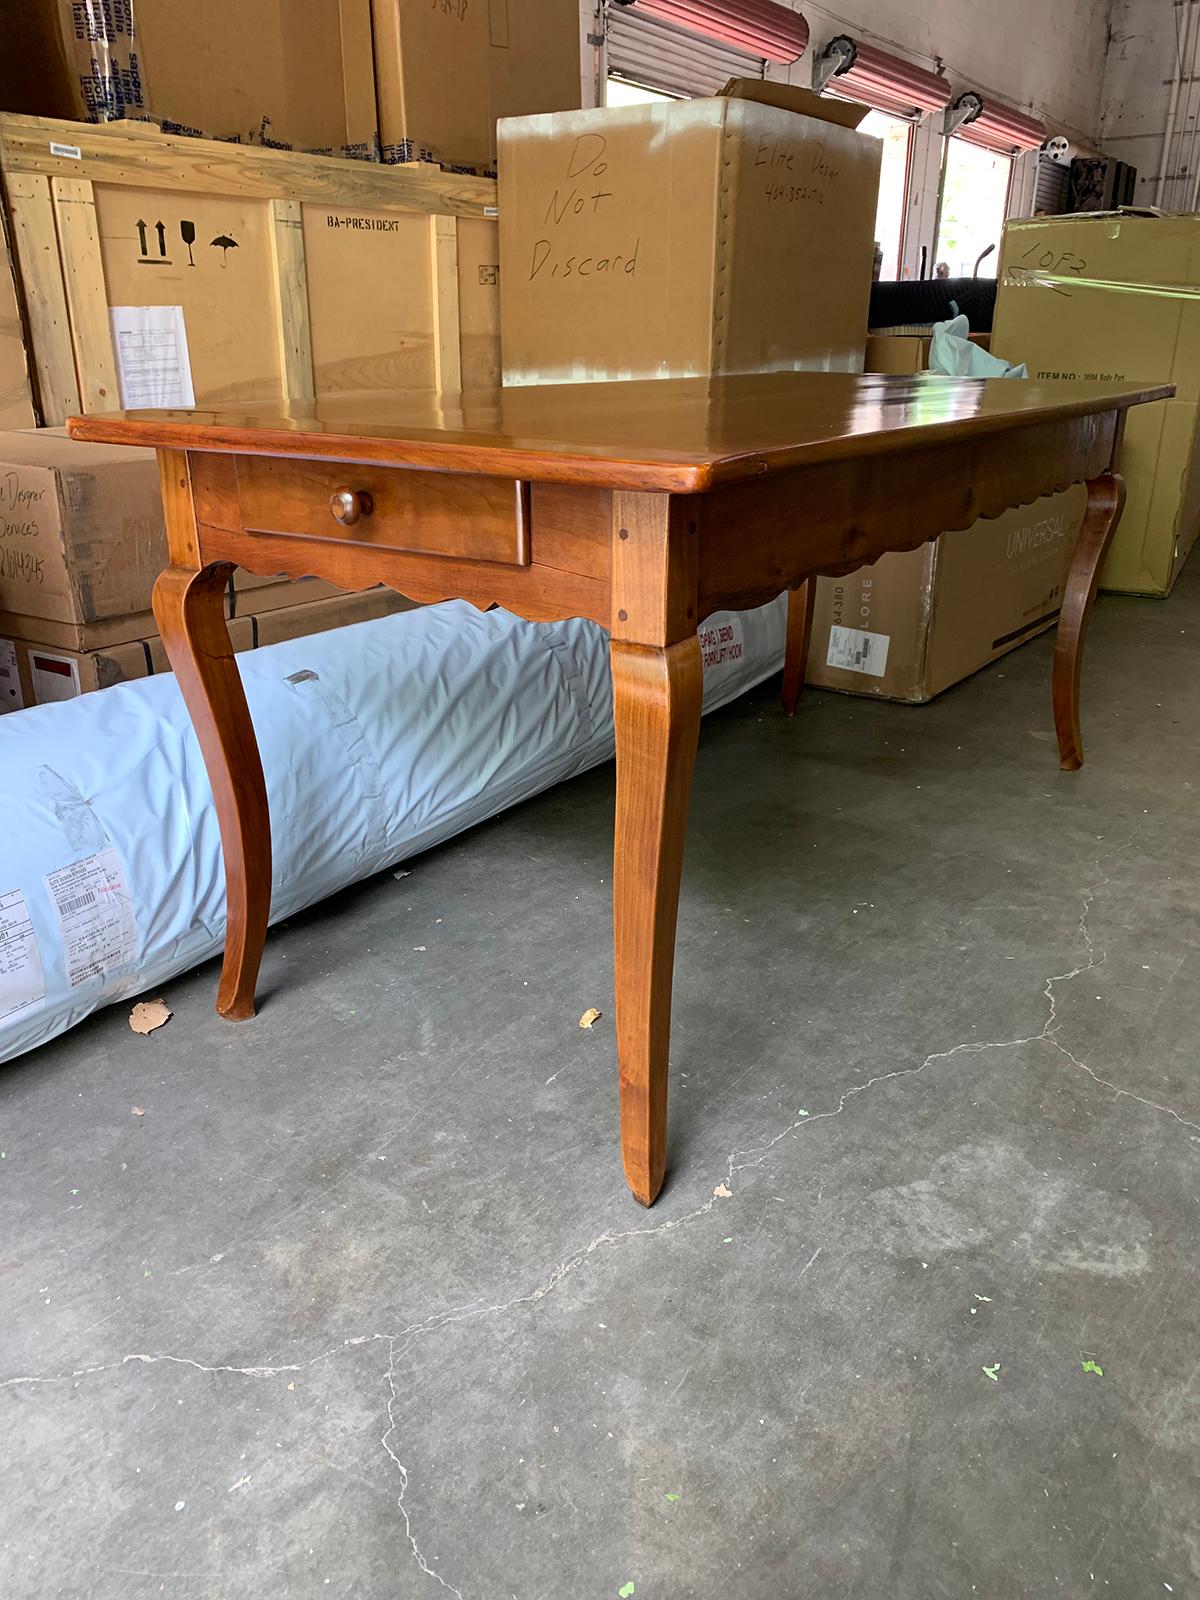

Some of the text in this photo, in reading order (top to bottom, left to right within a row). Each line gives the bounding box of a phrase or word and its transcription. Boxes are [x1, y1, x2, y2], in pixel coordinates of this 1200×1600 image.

[567, 133, 608, 179] Do
[327, 215, 400, 232] BA-PRESIDENT
[529, 238, 640, 281] Discard
[1037, 371, 1060, 380] ITEM
[1006, 514, 1065, 559] UNIVERSAL
